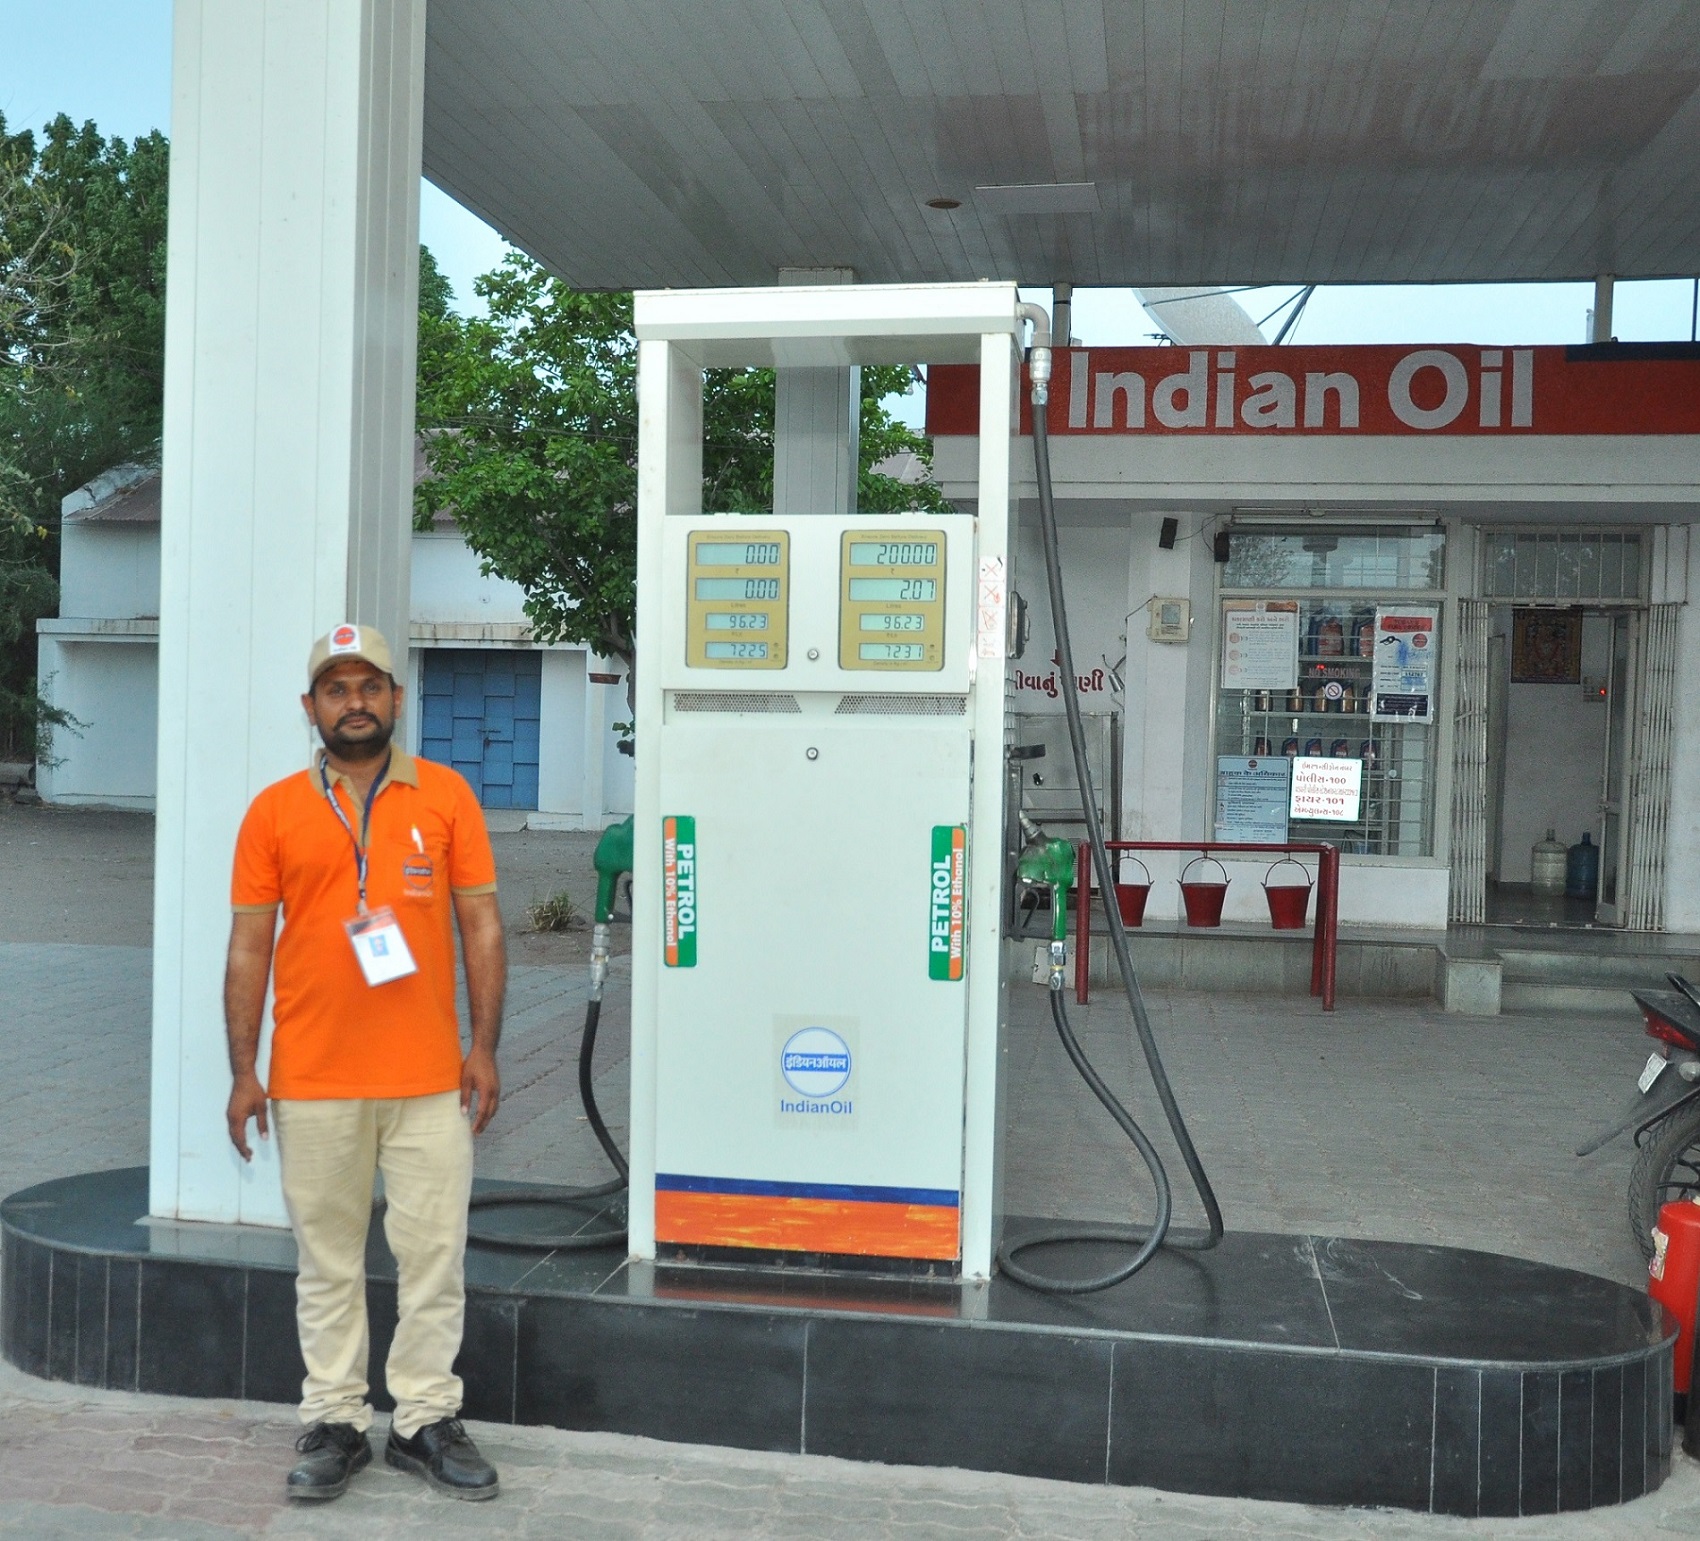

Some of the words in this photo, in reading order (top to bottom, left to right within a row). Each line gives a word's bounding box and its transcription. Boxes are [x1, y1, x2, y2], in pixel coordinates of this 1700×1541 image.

[1069, 350, 1360, 429] Indian
[1387, 349, 1534, 430] Oil
[745, 544, 779, 564] 0.00
[876, 544, 935, 564] 200.00
[745, 579, 779, 599] 0.00
[900, 580, 935, 600] 2.07
[729, 615, 767, 629] 96.23
[884, 616, 923, 630] 96.23
[1015, 669, 1058, 698] ીવાનું
[1322, 667, 1360, 679] SMOKING
[665, 838, 676, 867] With
[665, 870, 677, 897] 10%
[952, 848, 964, 896] Ethanol
[676, 843, 695, 940] PETROL
[931, 855, 951, 952] PETROL
[666, 899, 677, 946] Ethanol
[951, 898, 963, 926] 10%
[950, 930, 962, 959] With
[781, 1099, 852, 1114] IndianOil
